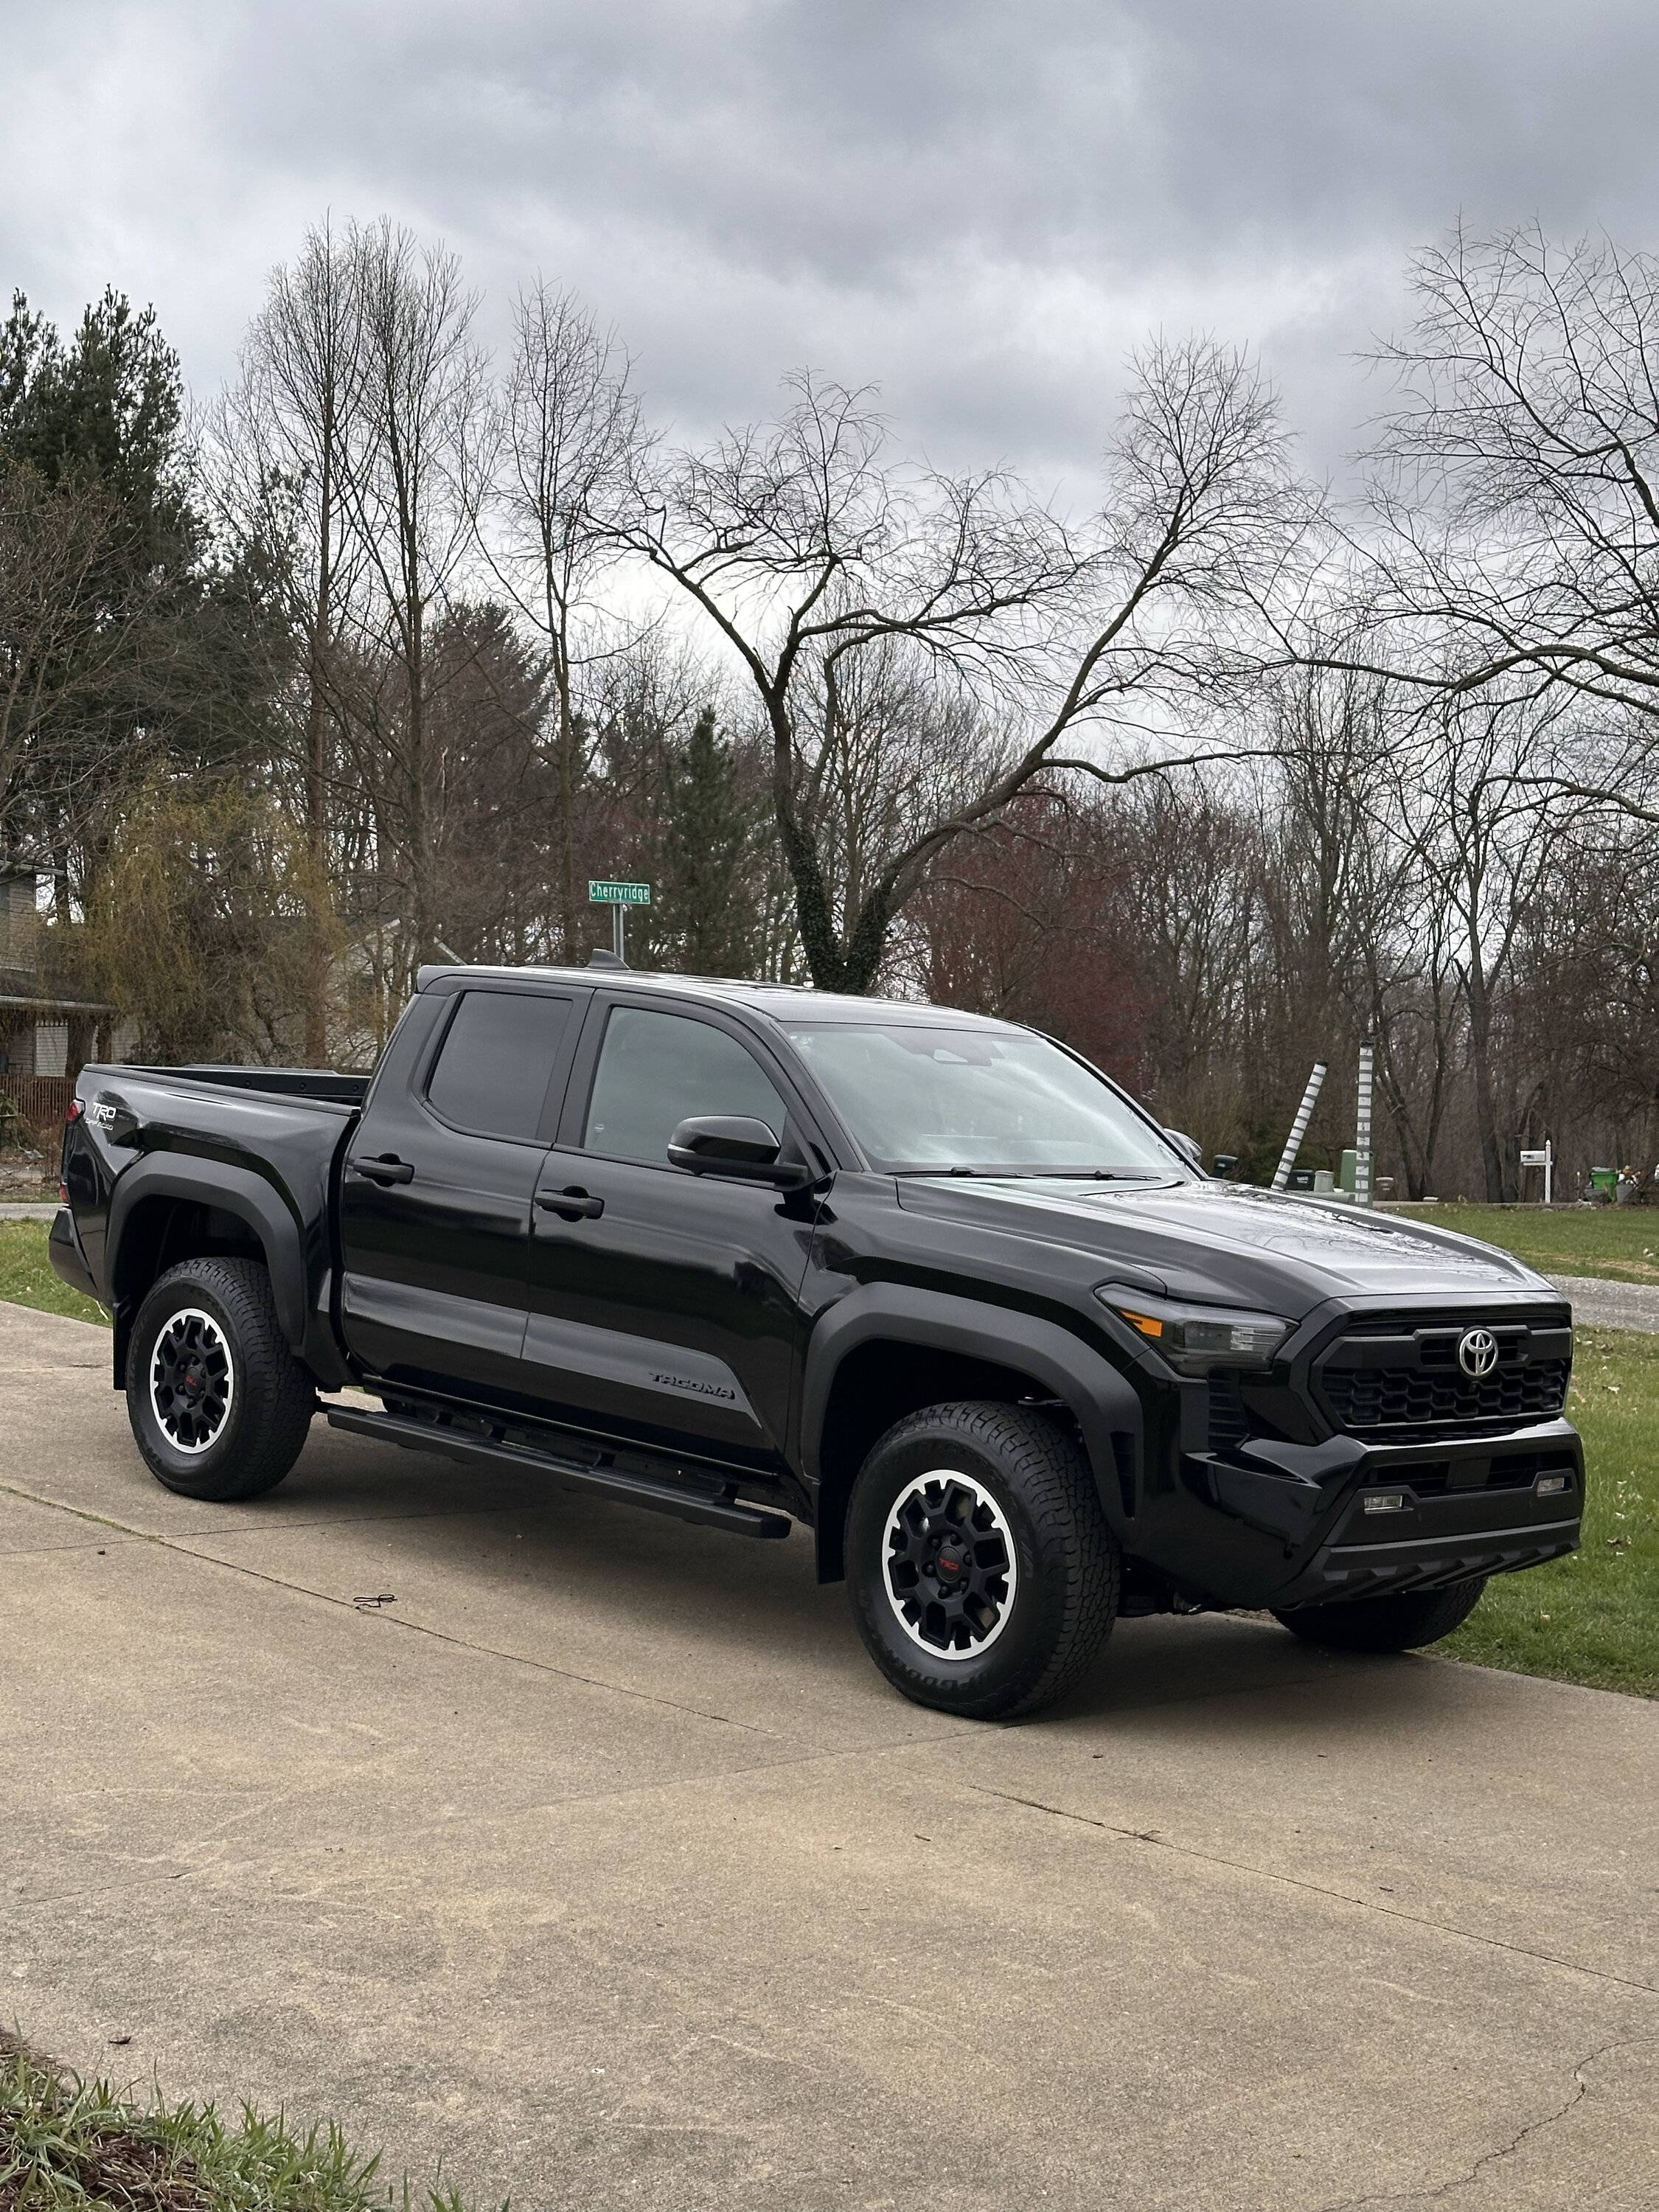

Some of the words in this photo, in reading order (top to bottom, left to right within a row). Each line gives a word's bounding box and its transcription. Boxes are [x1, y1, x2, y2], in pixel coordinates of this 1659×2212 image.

[591, 882, 649, 902] Cherryridge
[91, 1102, 116, 1121] TRD
[649, 1372, 736, 1400] TACOMA
